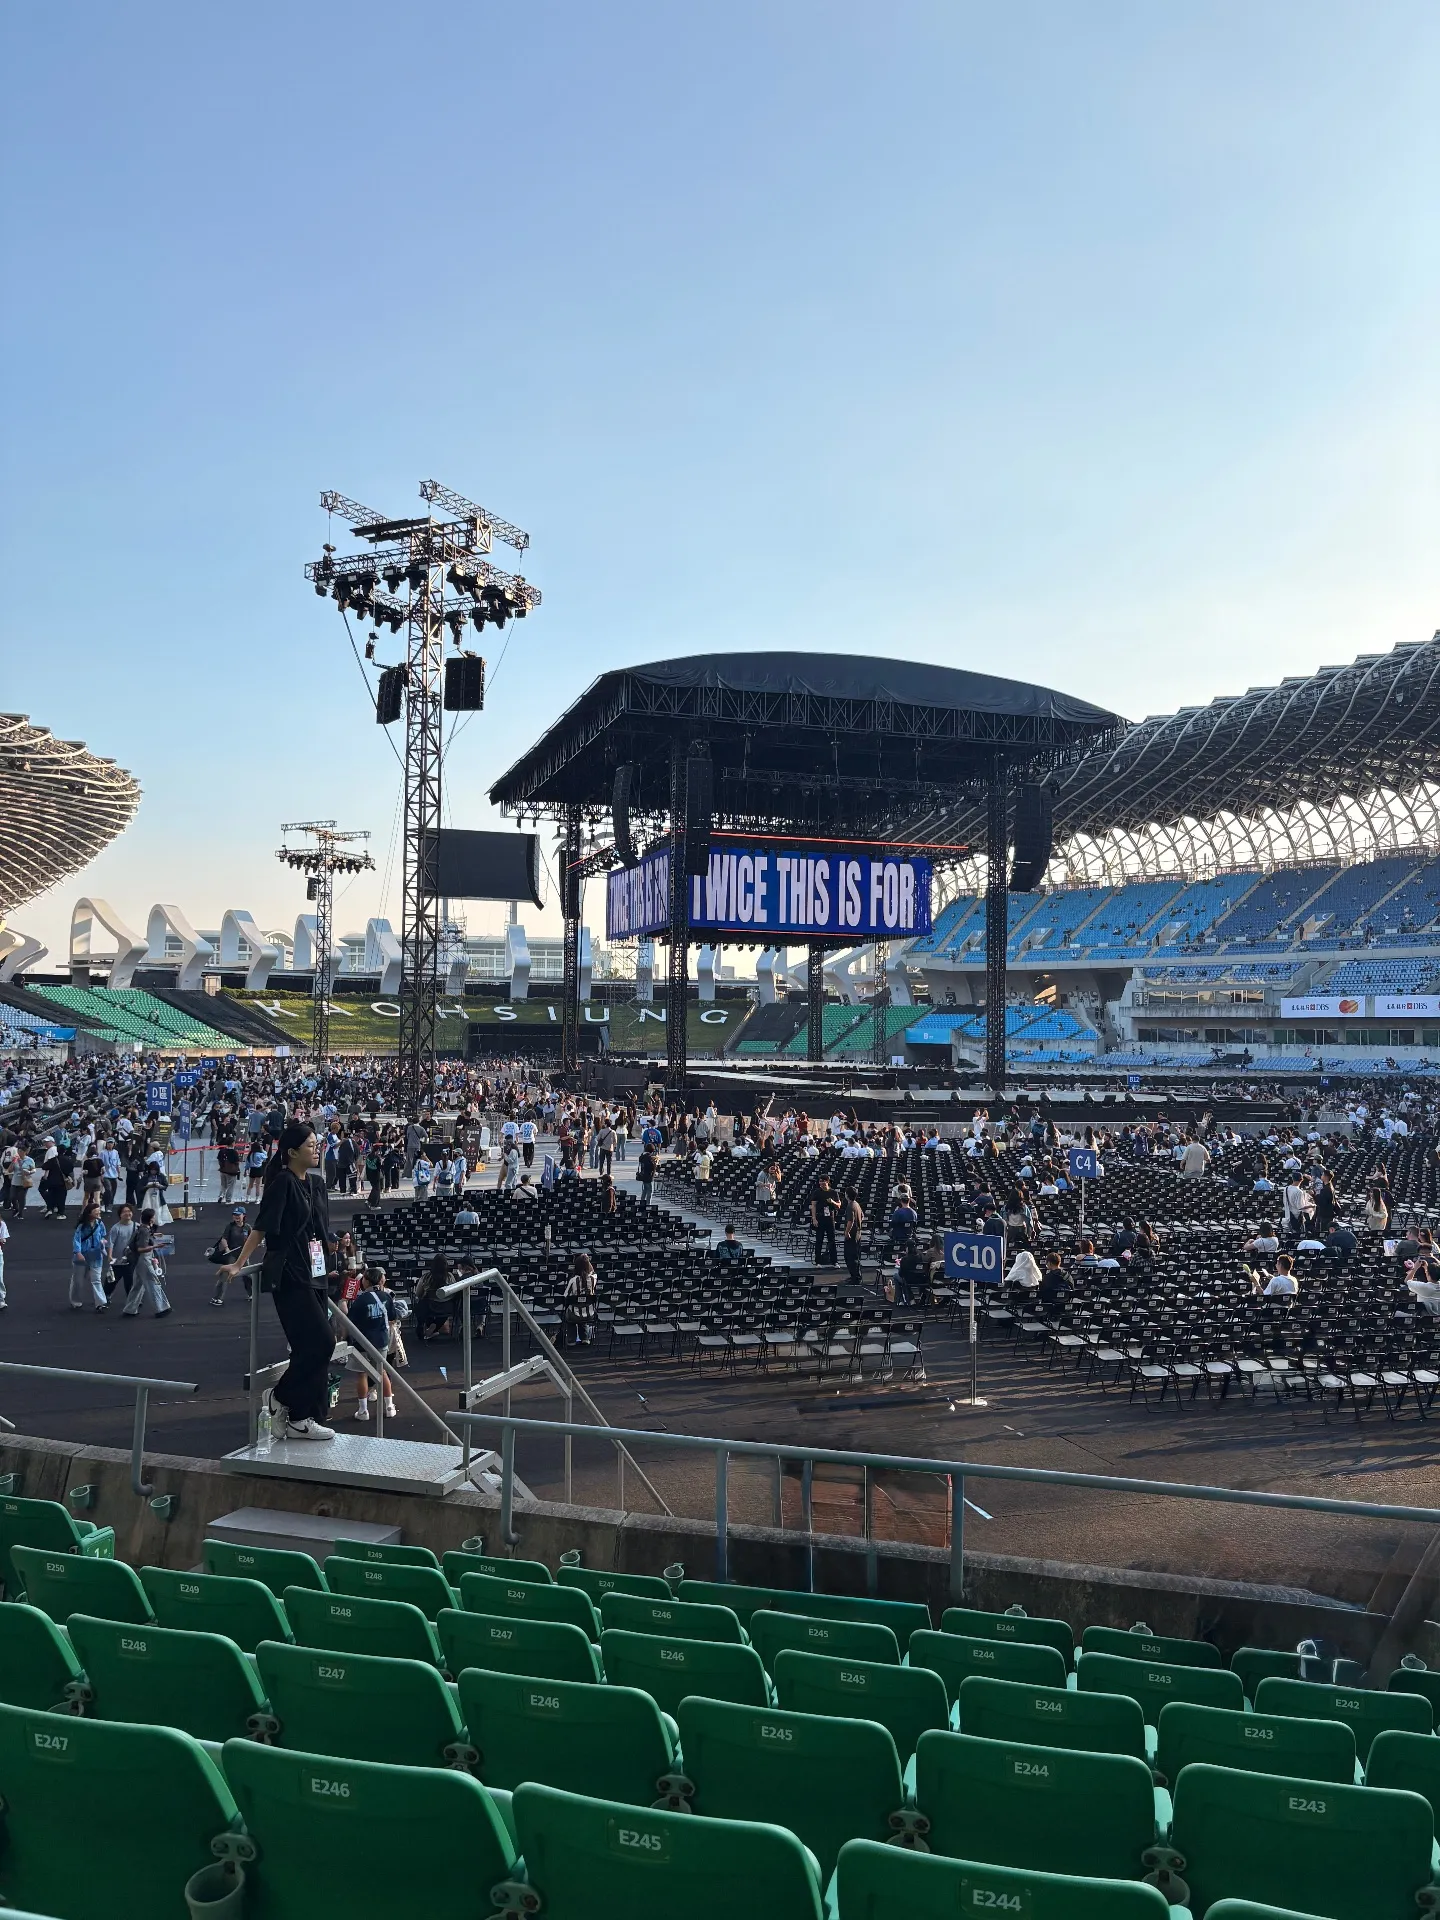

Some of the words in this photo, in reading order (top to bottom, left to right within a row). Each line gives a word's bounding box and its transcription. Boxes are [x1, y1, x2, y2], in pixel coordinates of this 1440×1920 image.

[610, 870, 629, 936] TWICE
[630, 865, 644, 930] THIS
[645, 861, 653, 926] IS
[654, 855, 669, 924] FOR
[693, 854, 767, 923] TWICE
[776, 858, 830, 926] THIS
[839, 861, 861, 927] IS
[869, 862, 915, 929] FOR
[253, 999, 729, 1024] KAOHSIUNG
[1075, 1155, 1091, 1171] C4
[951, 1242, 996, 1270] C10
[239, 1555, 255, 1564] E249
[367, 1551, 383, 1559] E249
[47, 1563, 65, 1573] E250
[480, 1565, 496, 1573] E248
[365, 1572, 383, 1581] E248
[180, 1584, 200, 1594] E249
[598, 1580, 615, 1588] E247
[508, 1590, 526, 1600] E247
[331, 1606, 352, 1618] E248
[652, 1610, 672, 1619] E246
[491, 1629, 513, 1640] E247
[809, 1629, 829, 1638] E245
[997, 1624, 1016, 1633] E244
[122, 1639, 147, 1652] E248
[1142, 1644, 1161, 1654] E243
[661, 1650, 685, 1662] E246
[973, 1650, 995, 1660] E244
[319, 1667, 346, 1680] E247
[841, 1672, 866, 1685] E245
[1149, 1674, 1172, 1684] E243
[531, 1695, 560, 1709] E246
[1036, 1700, 1063, 1713] E244
[1336, 1699, 1360, 1710] E242
[762, 1726, 792, 1741] E245
[1245, 1728, 1274, 1740] E243
[35, 1734, 68, 1751] E247
[1015, 1762, 1049, 1778] E244
[312, 1778, 350, 1798] E246
[1289, 1798, 1326, 1814] E243
[619, 1830, 661, 1851] E245
[973, 1889, 1022, 1912] E244
